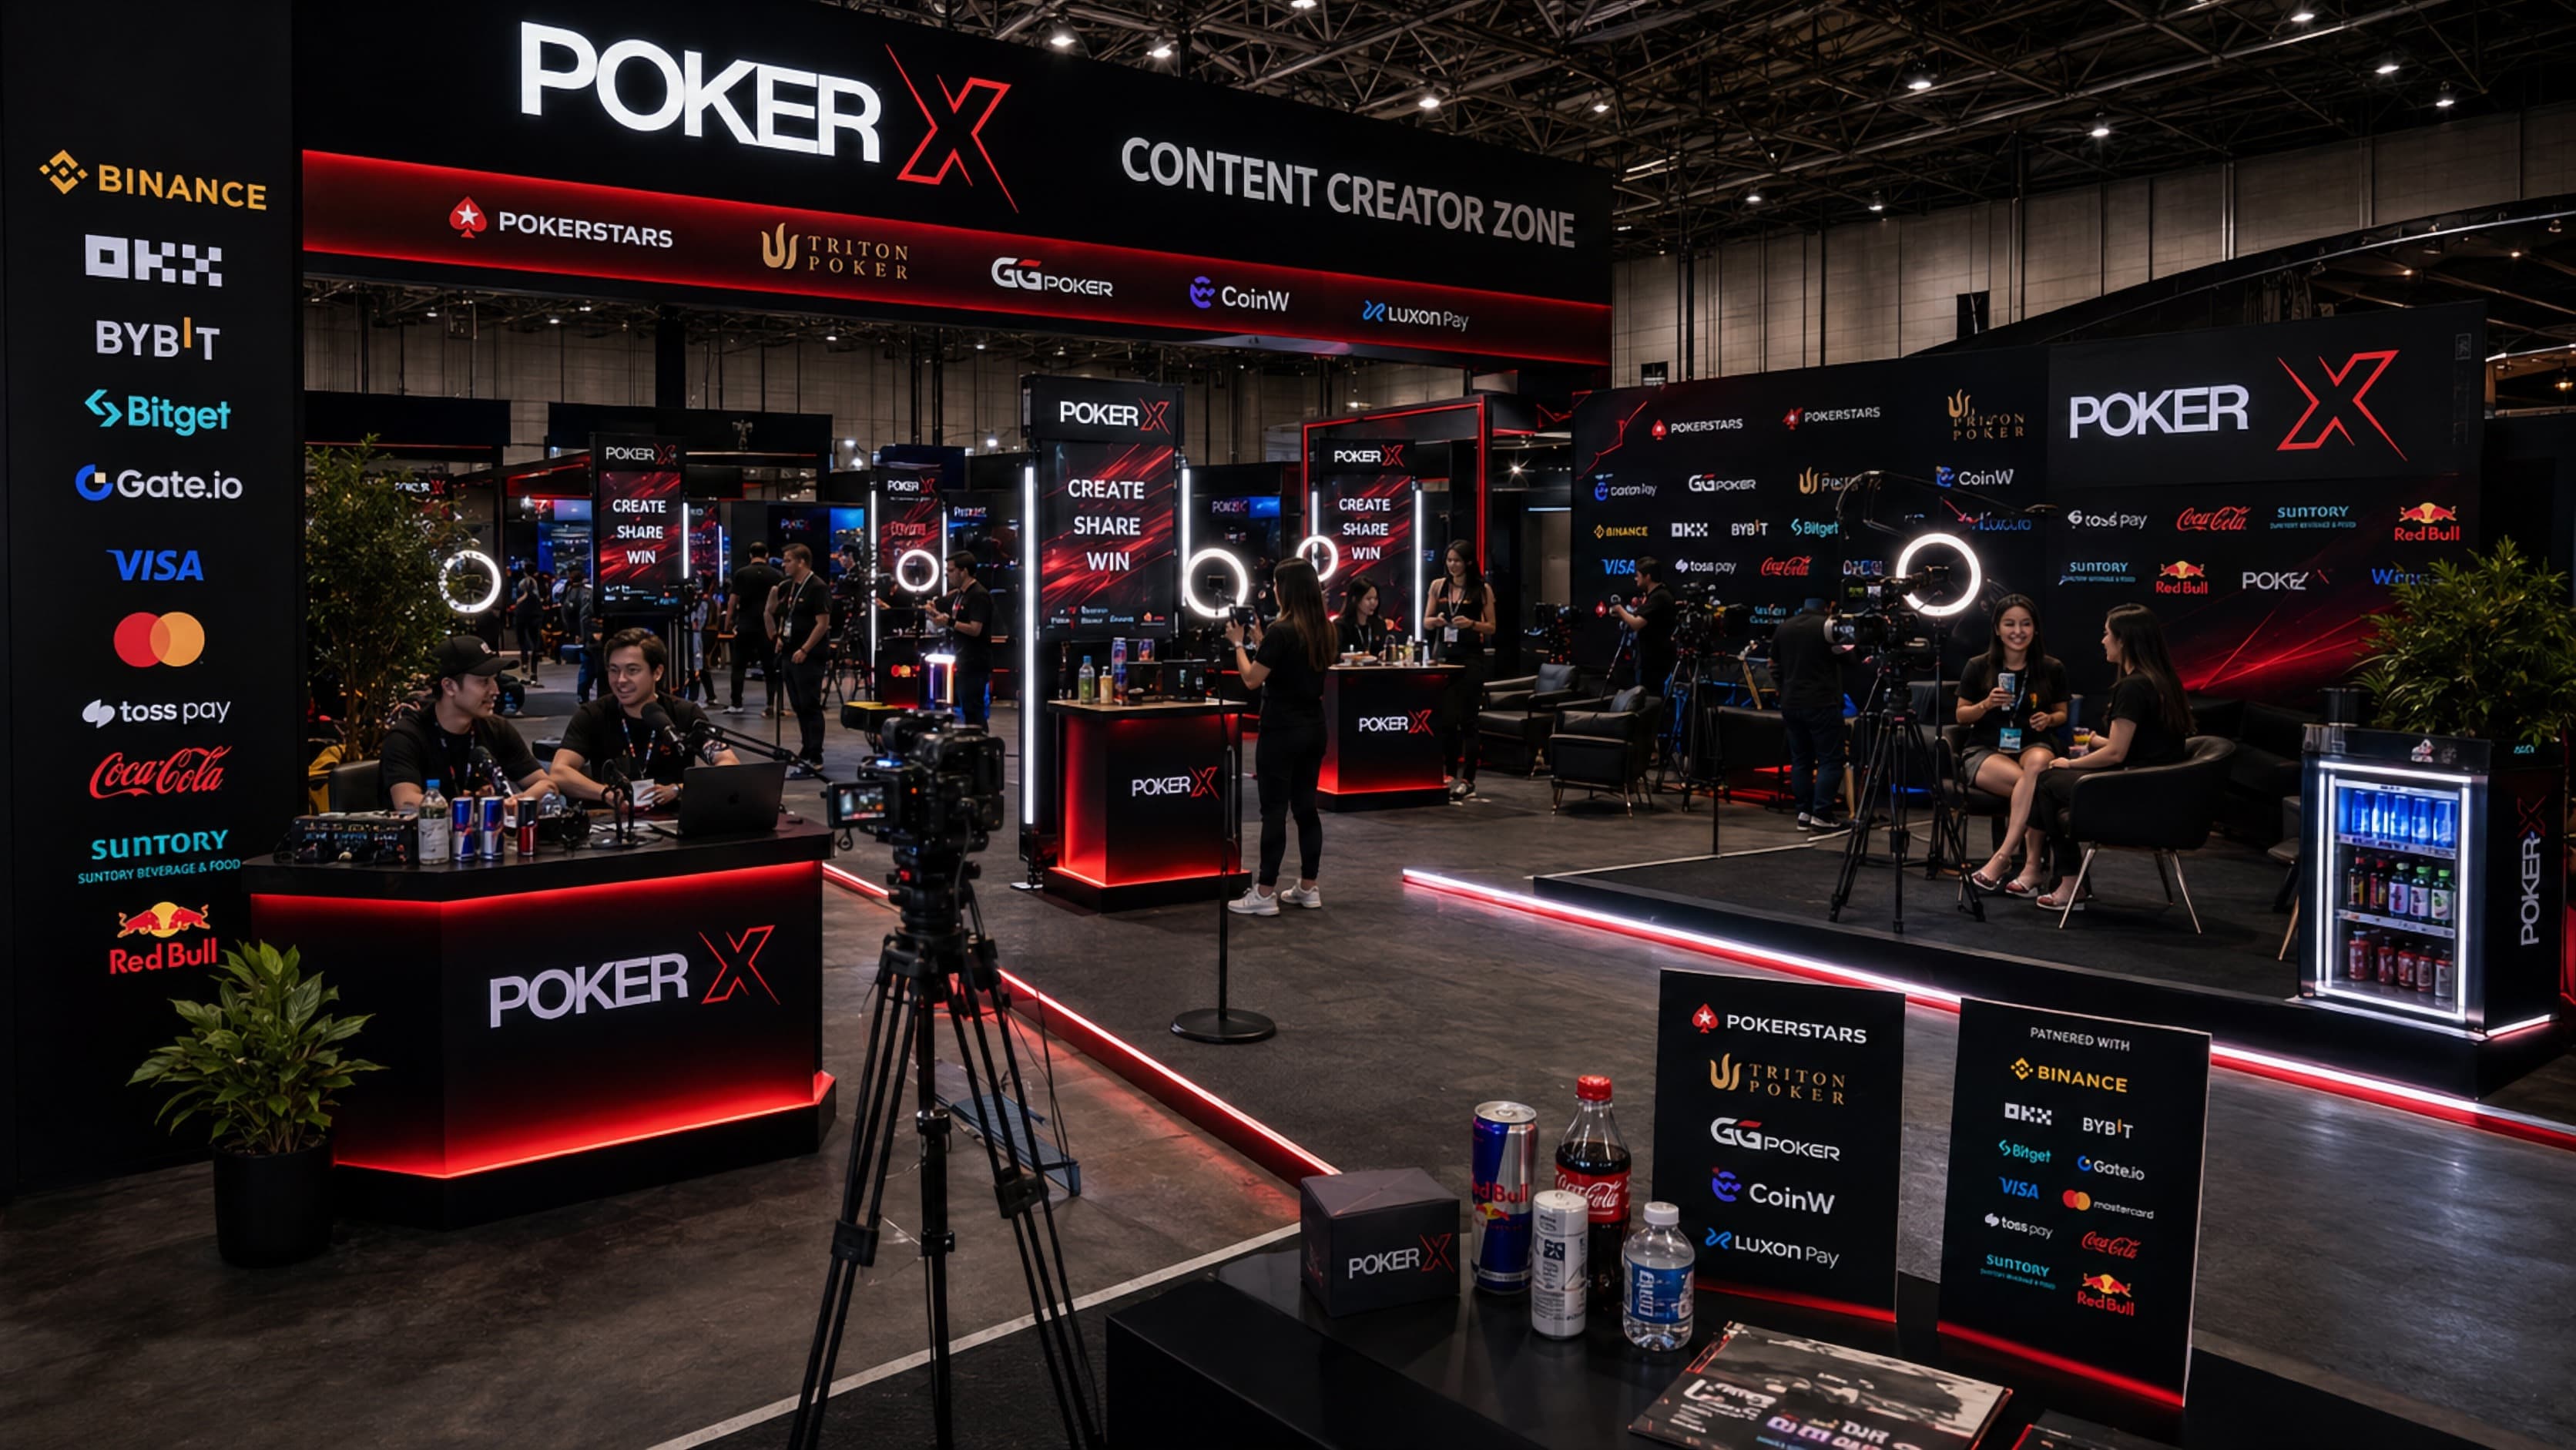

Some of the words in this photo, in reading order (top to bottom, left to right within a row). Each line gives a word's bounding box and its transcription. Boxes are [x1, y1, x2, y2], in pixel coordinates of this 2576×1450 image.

[521, 21, 882, 163] POKER
[885, 43, 1019, 213] X
[99, 164, 267, 210] BINANCE
[1122, 136, 1319, 207] CONTENT
[1327, 173, 1486, 235] CREATOR
[1493, 200, 1576, 249] ZONE
[498, 210, 674, 249] POKERSTARS
[807, 234, 910, 261] TRITON
[85, 233, 222, 287] OKX
[809, 255, 909, 280] POKER
[1221, 285, 1290, 313] CoinW
[1444, 310, 1470, 333] Pay
[96, 317, 220, 361] BYBIT
[128, 394, 231, 437] Bitget
[1059, 400, 1139, 427] POKER
[1139, 397, 1172, 435] X
[1804, 406, 1881, 423] POKERSTARS
[2069, 384, 2249, 439] POKER
[2276, 349, 2408, 462] X
[1671, 418, 1743, 434] POKERSTARS
[1954, 425, 2025, 441] POKER
[605, 446, 655, 461] POKER
[1333, 450, 1381, 463] POKER
[1381, 443, 1405, 468] X
[117, 468, 243, 499] Gate.io
[1068, 478, 1145, 500] CREATE
[1958, 468, 2014, 486] CoinW
[612, 498, 666, 514] CREATE
[1339, 498, 1391, 512] CREATE
[616, 525, 664, 540] SHARE
[1073, 515, 1142, 535] SHARE
[1342, 522, 1389, 536] SHARE
[1605, 526, 1649, 537] BINANCE
[1671, 522, 1709, 538] OKX
[1731, 519, 1769, 537] BYBIT
[1804, 520, 1839, 538] Bitget
[2394, 526, 2426, 542] Red
[2428, 525, 2460, 542] Bull
[106, 549, 204, 581] VISA
[626, 549, 656, 565] WIN
[1086, 551, 1130, 572] WIN
[1350, 546, 1381, 561] WIN
[1601, 559, 1635, 576] VISA
[1715, 561, 1737, 576] pay
[2155, 580, 2181, 594] Red
[2182, 581, 2209, 595] Bull
[119, 701, 177, 723] toss
[183, 701, 231, 725] pay
[1358, 714, 1409, 733] POKER
[1407, 708, 1434, 737] X
[1132, 776, 1190, 797] POKER
[1189, 766, 1221, 801] X
[78, 868, 134, 884] SUNTORY
[137, 862, 196, 878] BEVERAGE
[198, 861, 207, 873] &
[210, 858, 241, 871] FOOD
[2521, 837, 2541, 946] POKER
[109, 944, 163, 975] Red
[168, 938, 218, 968] Bull
[489, 952, 689, 1029] POKER
[698, 925, 780, 1005] X
[1726, 1013, 1868, 1045] POKERSTARS
[2030, 1026, 2095, 1046] PATNERED
[2097, 1036, 2131, 1052] WITH
[1748, 1062, 1846, 1089] TRITON
[2038, 1066, 2128, 1093] BINANCE
[1749, 1080, 1846, 1106] POKER
[2004, 1102, 2052, 1126] OKX
[2082, 1118, 2134, 1140] BYBIT
[2012, 1143, 2051, 1163] Bitget
[2093, 1160, 2145, 1181] Gate.io
[1749, 1183, 1835, 1215] CoinW
[1998, 1176, 2040, 1200] VISA
[2093, 1200, 2155, 1220] mastercard
[2001, 1216, 2028, 1234] toss
[2028, 1224, 2053, 1240] pay
[1348, 1247, 1420, 1280] POKER
[1419, 1233, 1455, 1274] X
[1806, 1246, 1840, 1270] Pay
[2077, 1291, 2105, 1310] Red
[2106, 1298, 2135, 1317] Bull
